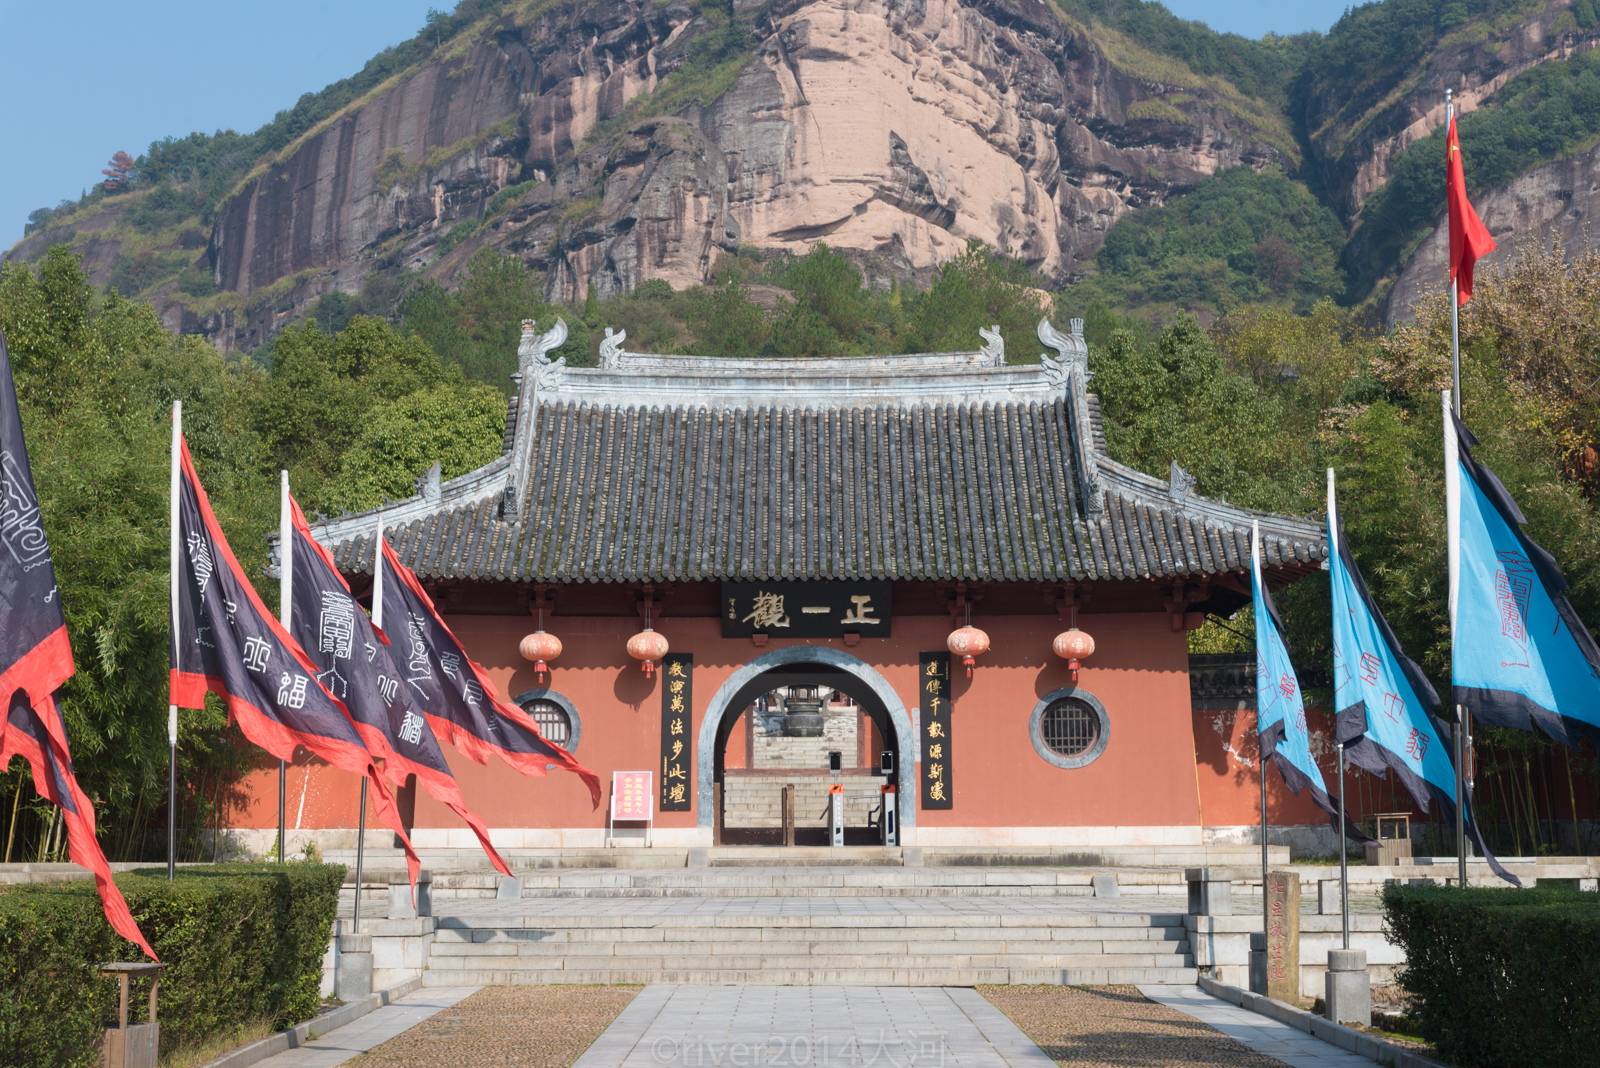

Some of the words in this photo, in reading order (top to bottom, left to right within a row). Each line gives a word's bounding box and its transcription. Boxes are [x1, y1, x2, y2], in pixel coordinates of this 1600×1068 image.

[1269, 880, 1287, 980] 七星放生池
